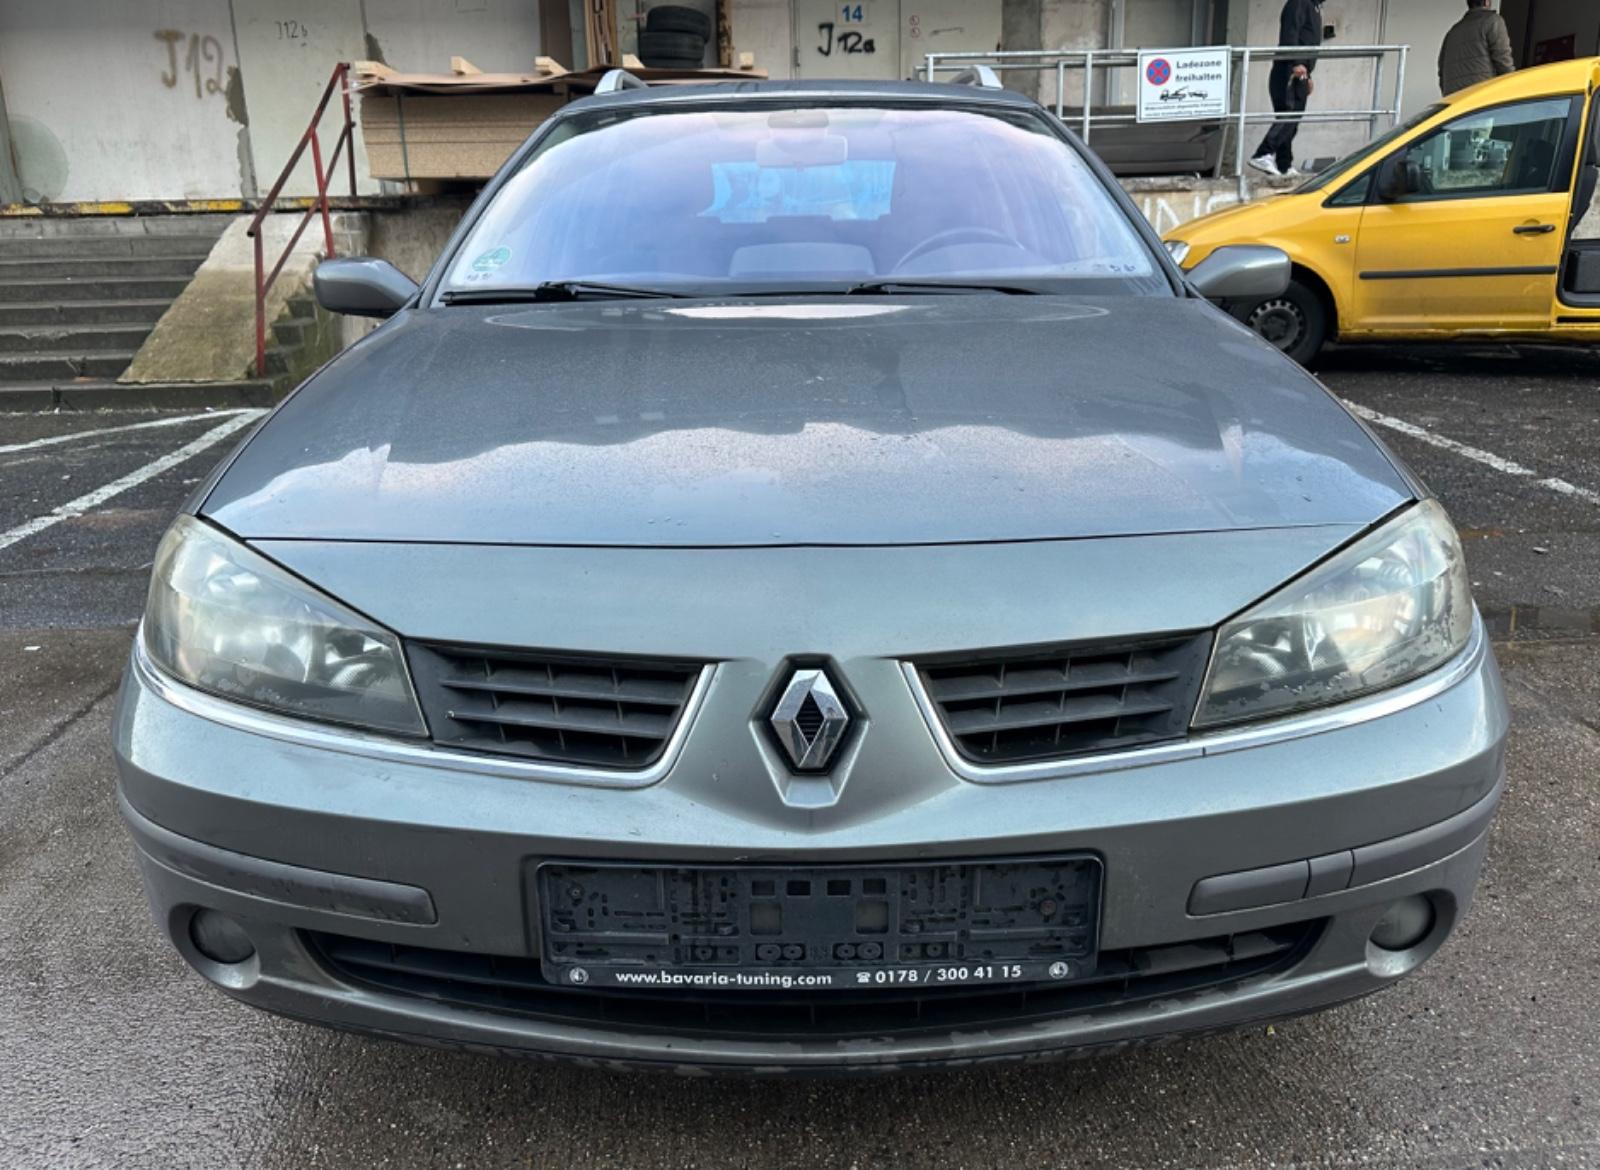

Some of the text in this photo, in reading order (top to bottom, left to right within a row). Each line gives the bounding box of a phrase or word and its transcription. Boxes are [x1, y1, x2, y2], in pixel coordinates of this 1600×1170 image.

[842, 5, 864, 22] 14
[153, 28, 226, 99] J12
[1176, 60, 1222, 69] Ladezone
[1175, 73, 1222, 82] freihalten
[616, 970, 832, 988] www.bavaria-tuning.com
[875, 970, 918, 983] 0178
[937, 967, 968, 981] 300
[974, 966, 993, 979] 41
[1002, 965, 1022, 978] 15
